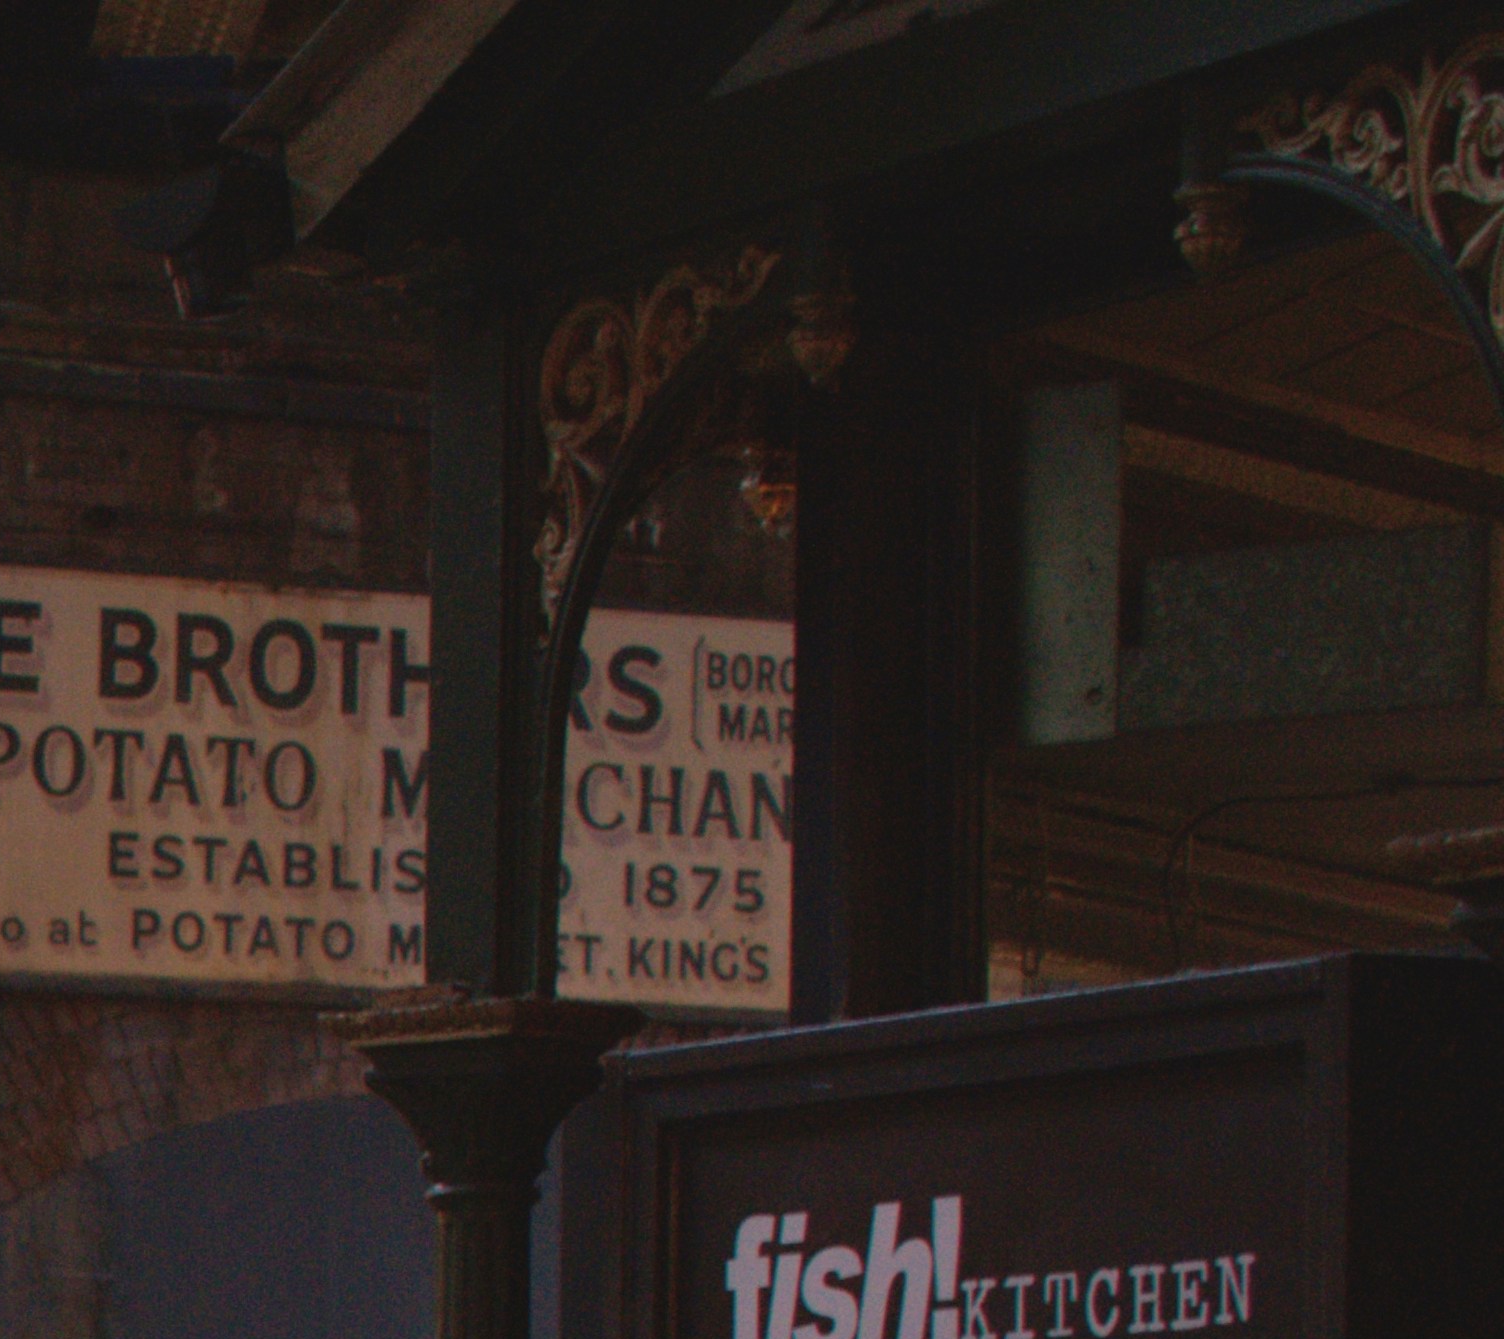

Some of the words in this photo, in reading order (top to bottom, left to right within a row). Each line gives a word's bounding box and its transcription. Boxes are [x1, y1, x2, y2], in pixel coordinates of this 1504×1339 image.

[98, 607, 666, 735] BROTHS
[622, 861, 766, 914] 1875
[48, 910, 98, 946] at
[132, 908, 355, 961] POTATO
[627, 936, 770, 985] KING'S
